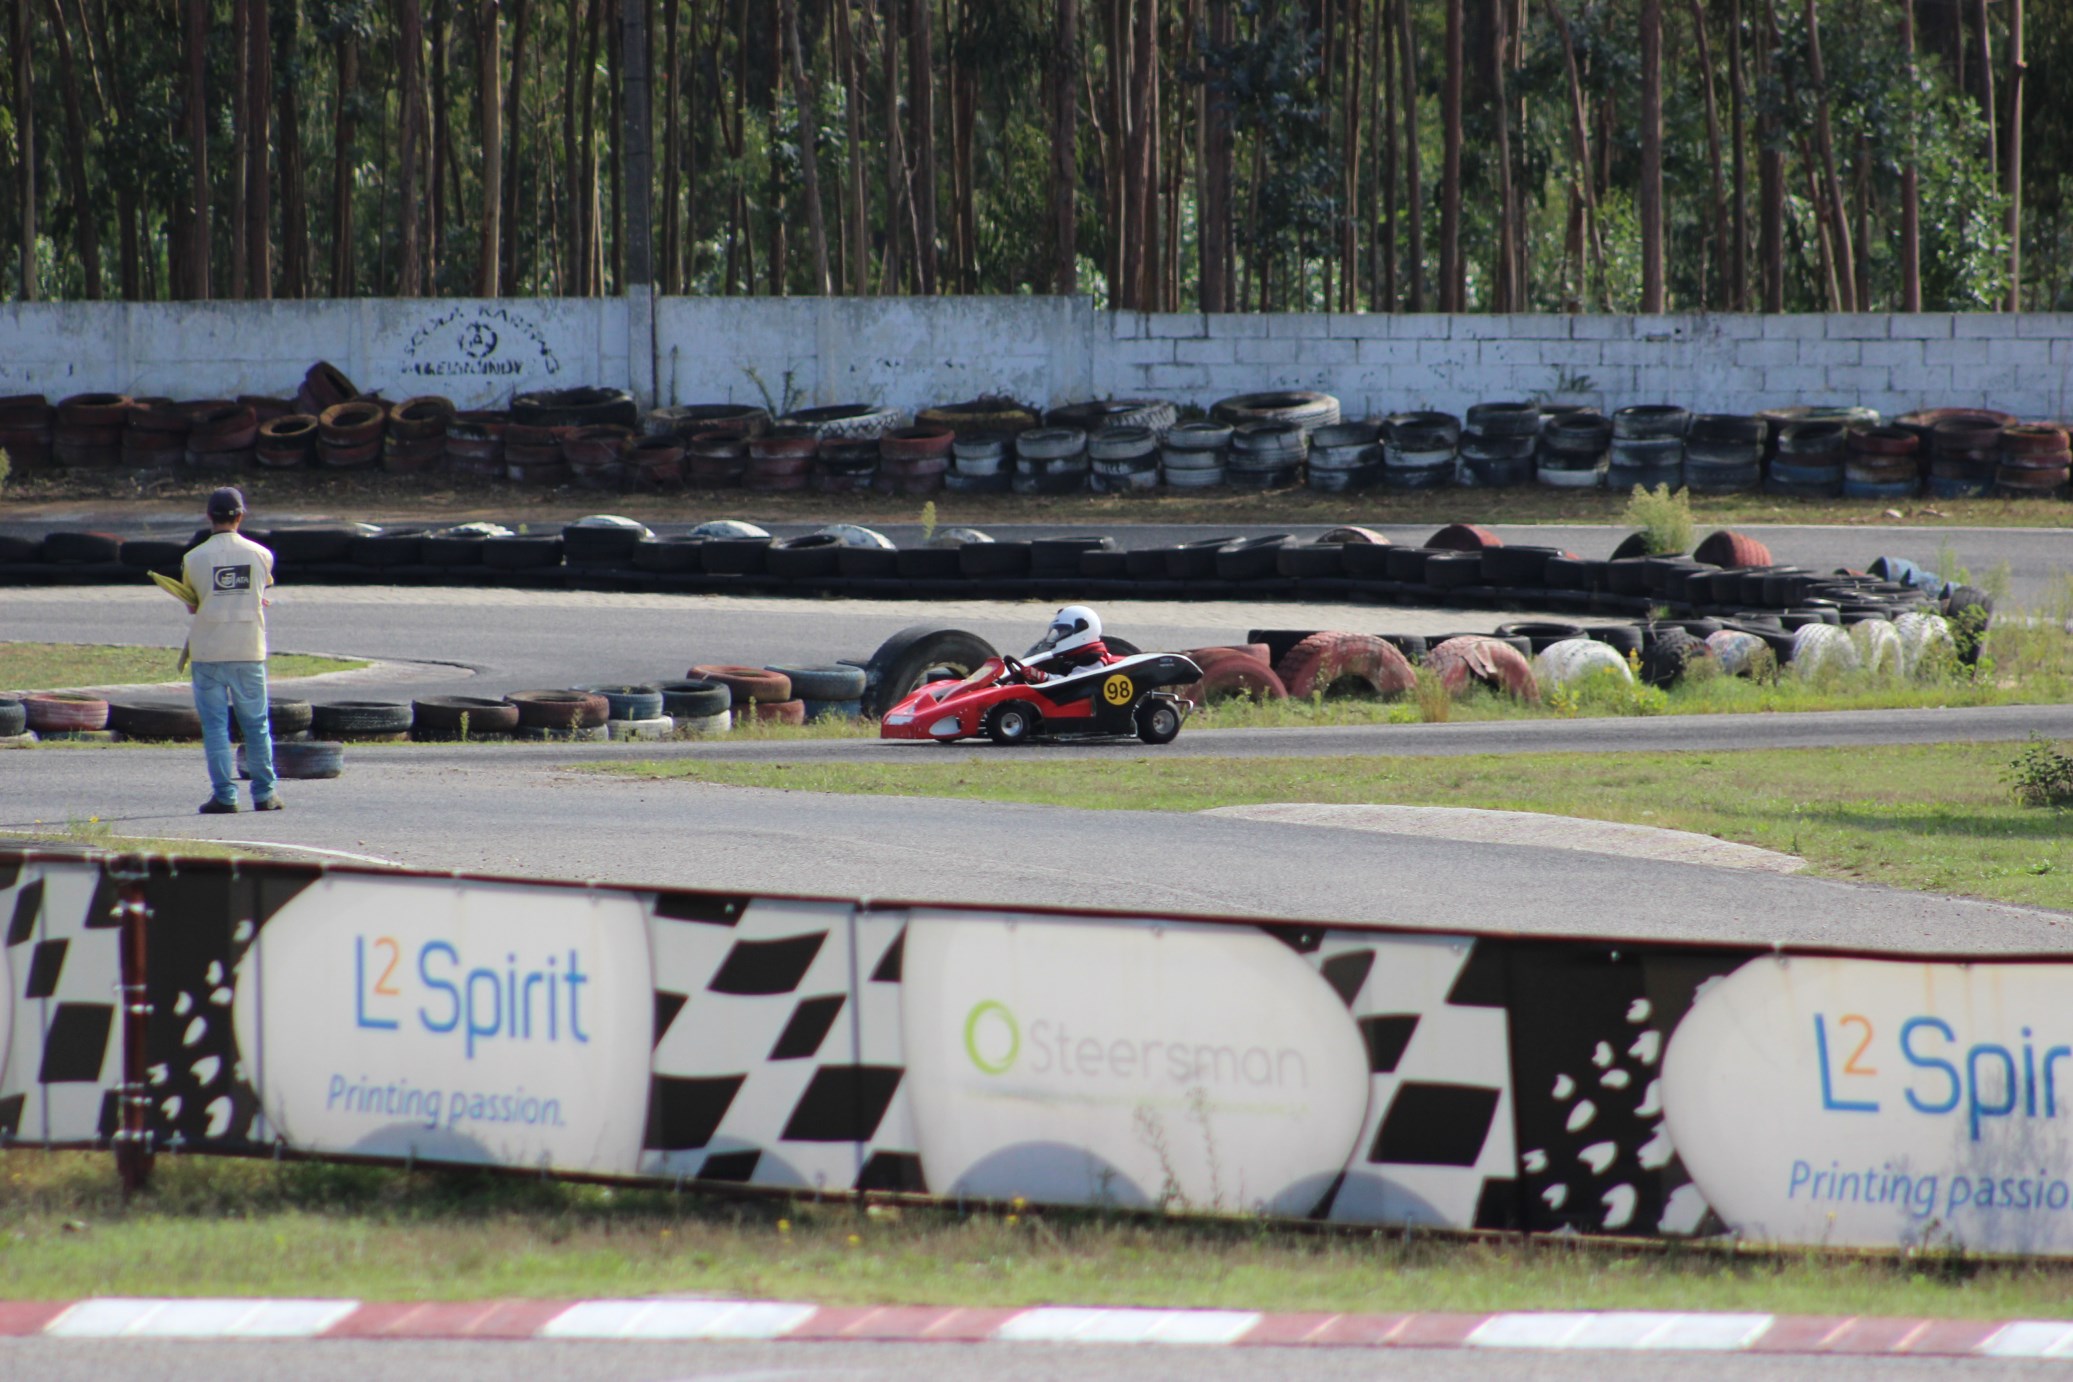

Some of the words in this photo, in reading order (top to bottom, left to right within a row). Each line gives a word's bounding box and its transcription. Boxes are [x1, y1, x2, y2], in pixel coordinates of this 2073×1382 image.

[1107, 680, 1130, 700] 98
[418, 940, 589, 1060] Spirit
[1030, 1018, 1309, 1088] Steersman
[1899, 1015, 2072, 1142] Spir
[326, 1072, 443, 1130] Printing
[1788, 1159, 1937, 1220] Printing
